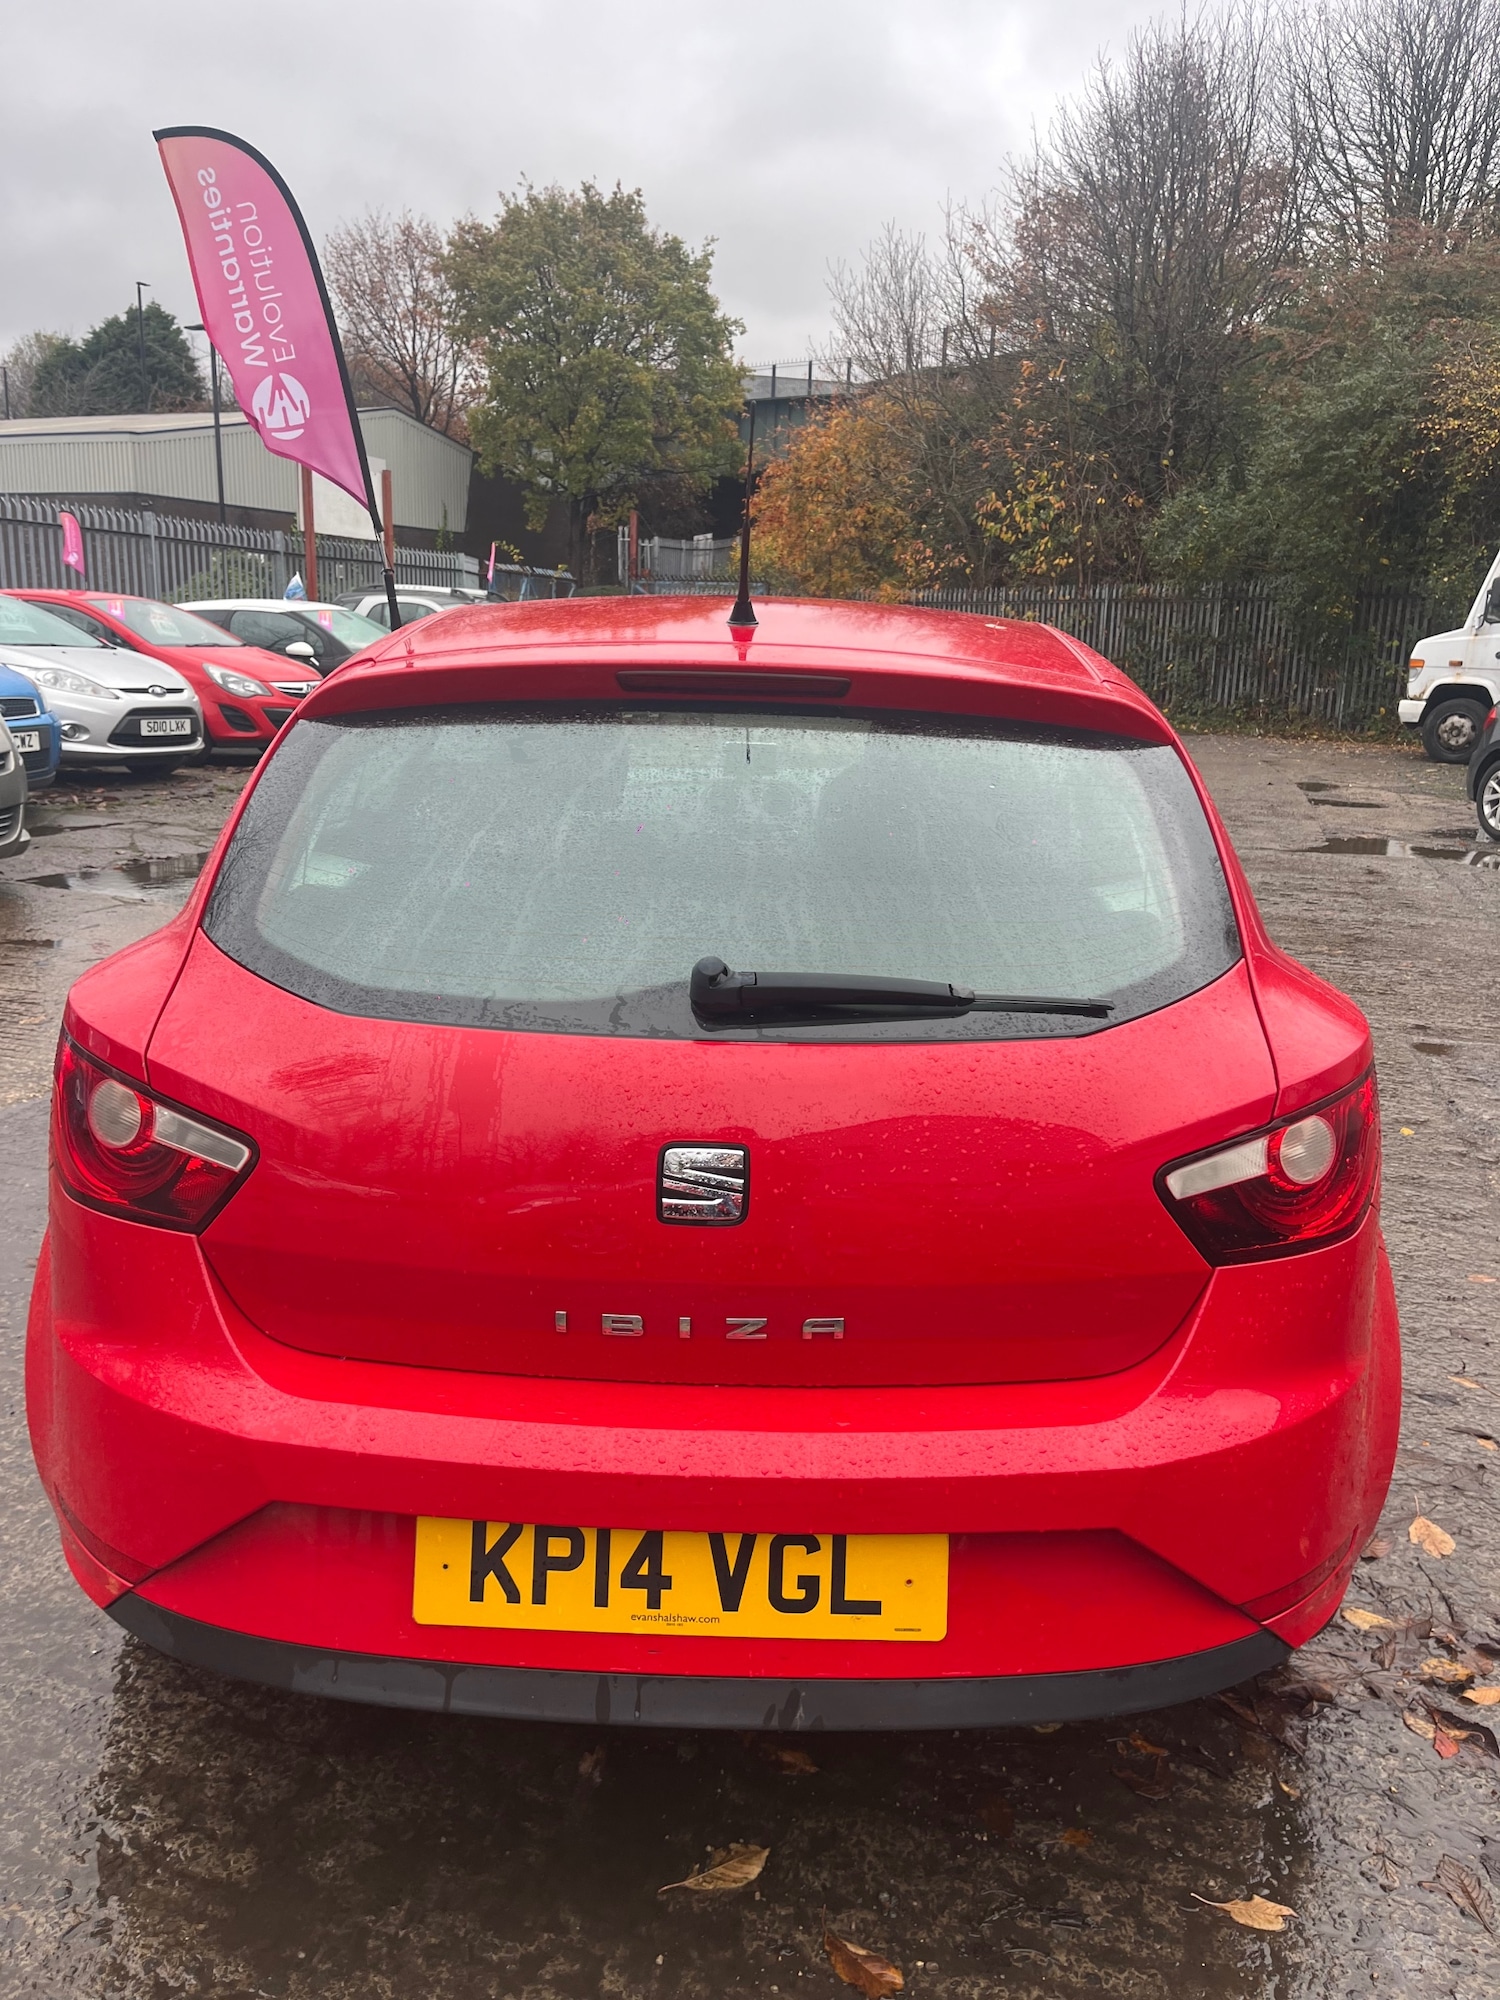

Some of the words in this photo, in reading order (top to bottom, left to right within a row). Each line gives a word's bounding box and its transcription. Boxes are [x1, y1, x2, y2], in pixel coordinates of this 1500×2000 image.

[146, 721, 167, 733] SD10
[169, 720, 186, 732] LXK
[555, 1311, 845, 1340] IBIZA
[469, 1520, 673, 1610] KP14
[706, 1531, 882, 1616] VGL
[630, 1612, 720, 1624] evanshalshaw.com
